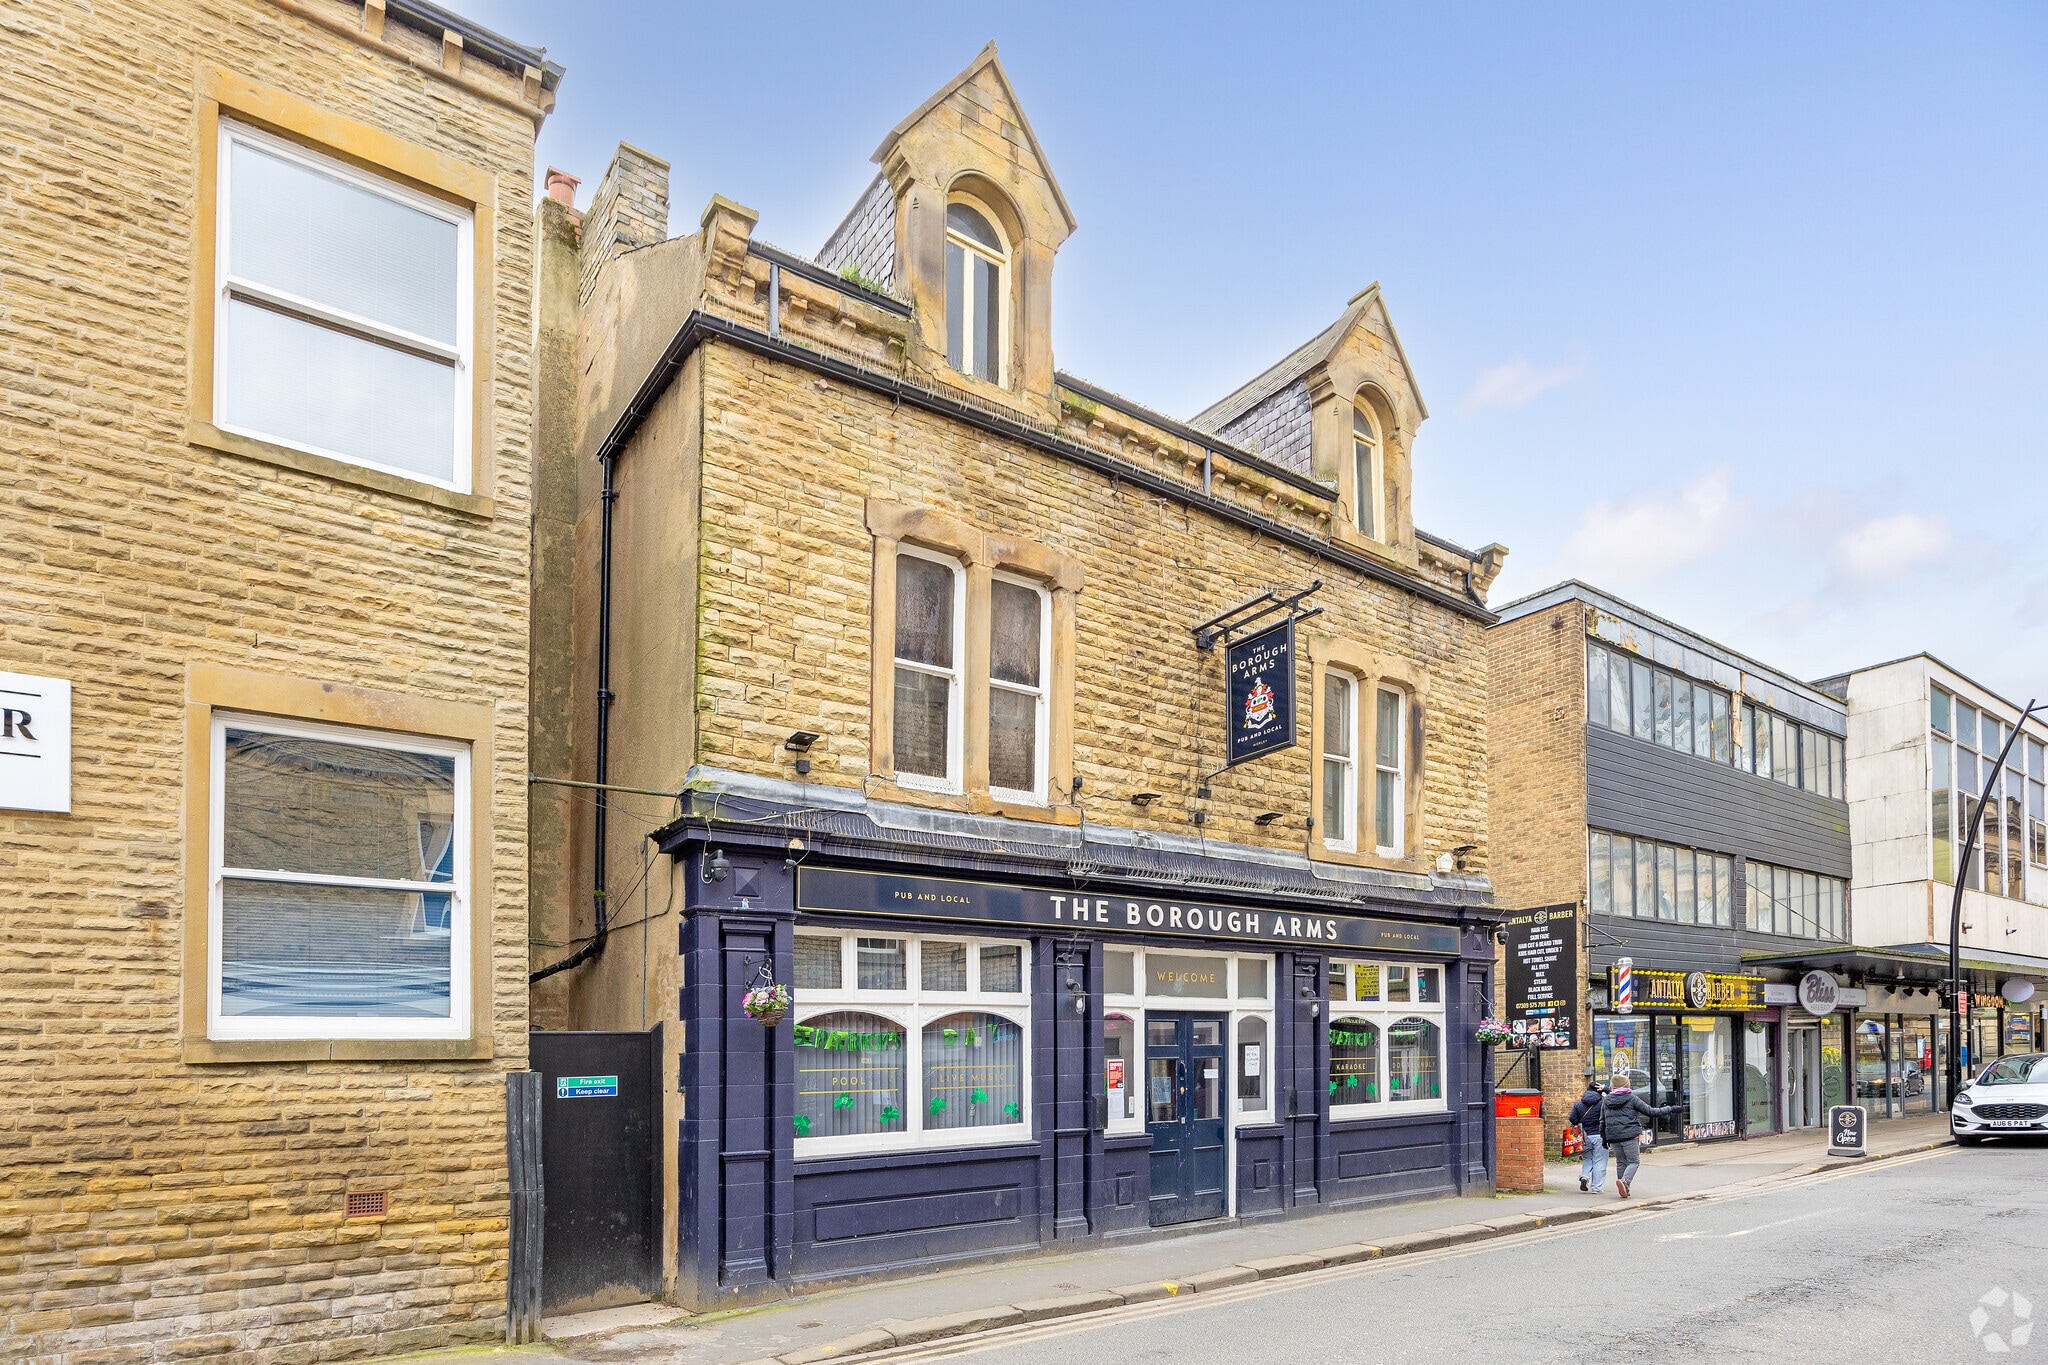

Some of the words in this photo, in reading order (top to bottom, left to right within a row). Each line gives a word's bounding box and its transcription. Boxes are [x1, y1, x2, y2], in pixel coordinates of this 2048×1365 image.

[1253, 645, 1265, 654] THE
[1232, 643, 1287, 673] BOROUGH
[1243, 659, 1275, 679] ARMS
[1237, 735, 1248, 743] PUB
[1250, 731, 1262, 740] AND
[1263, 724, 1282, 734] LOCAL
[895, 891, 913, 900] PUB
[917, 893, 936, 901] AND
[941, 895, 970, 904] LOCAL
[1050, 896, 1109, 922] THE
[1126, 903, 1259, 934] BOROUGH
[1273, 915, 1337, 940] ARMS
[1549, 910, 1573, 920] BARBER
[1157, 971, 1215, 983] WELCOME
[1651, 979, 1685, 1000] ANTALYA
[1707, 981, 1735, 1001] BARBER
[1806, 973, 1835, 1004] Bliss
[814, 1028, 901, 1051] PATRICK'S
[1336, 1063, 1366, 1071] KARAOKE
[832, 1077, 866, 1086] POOL
[940, 1074, 964, 1083] LIVE
[971, 1072, 1005, 1081] MUSIC
[1836, 1132, 1857, 1144] Open
[1843, 1128, 1857, 1136] Now
